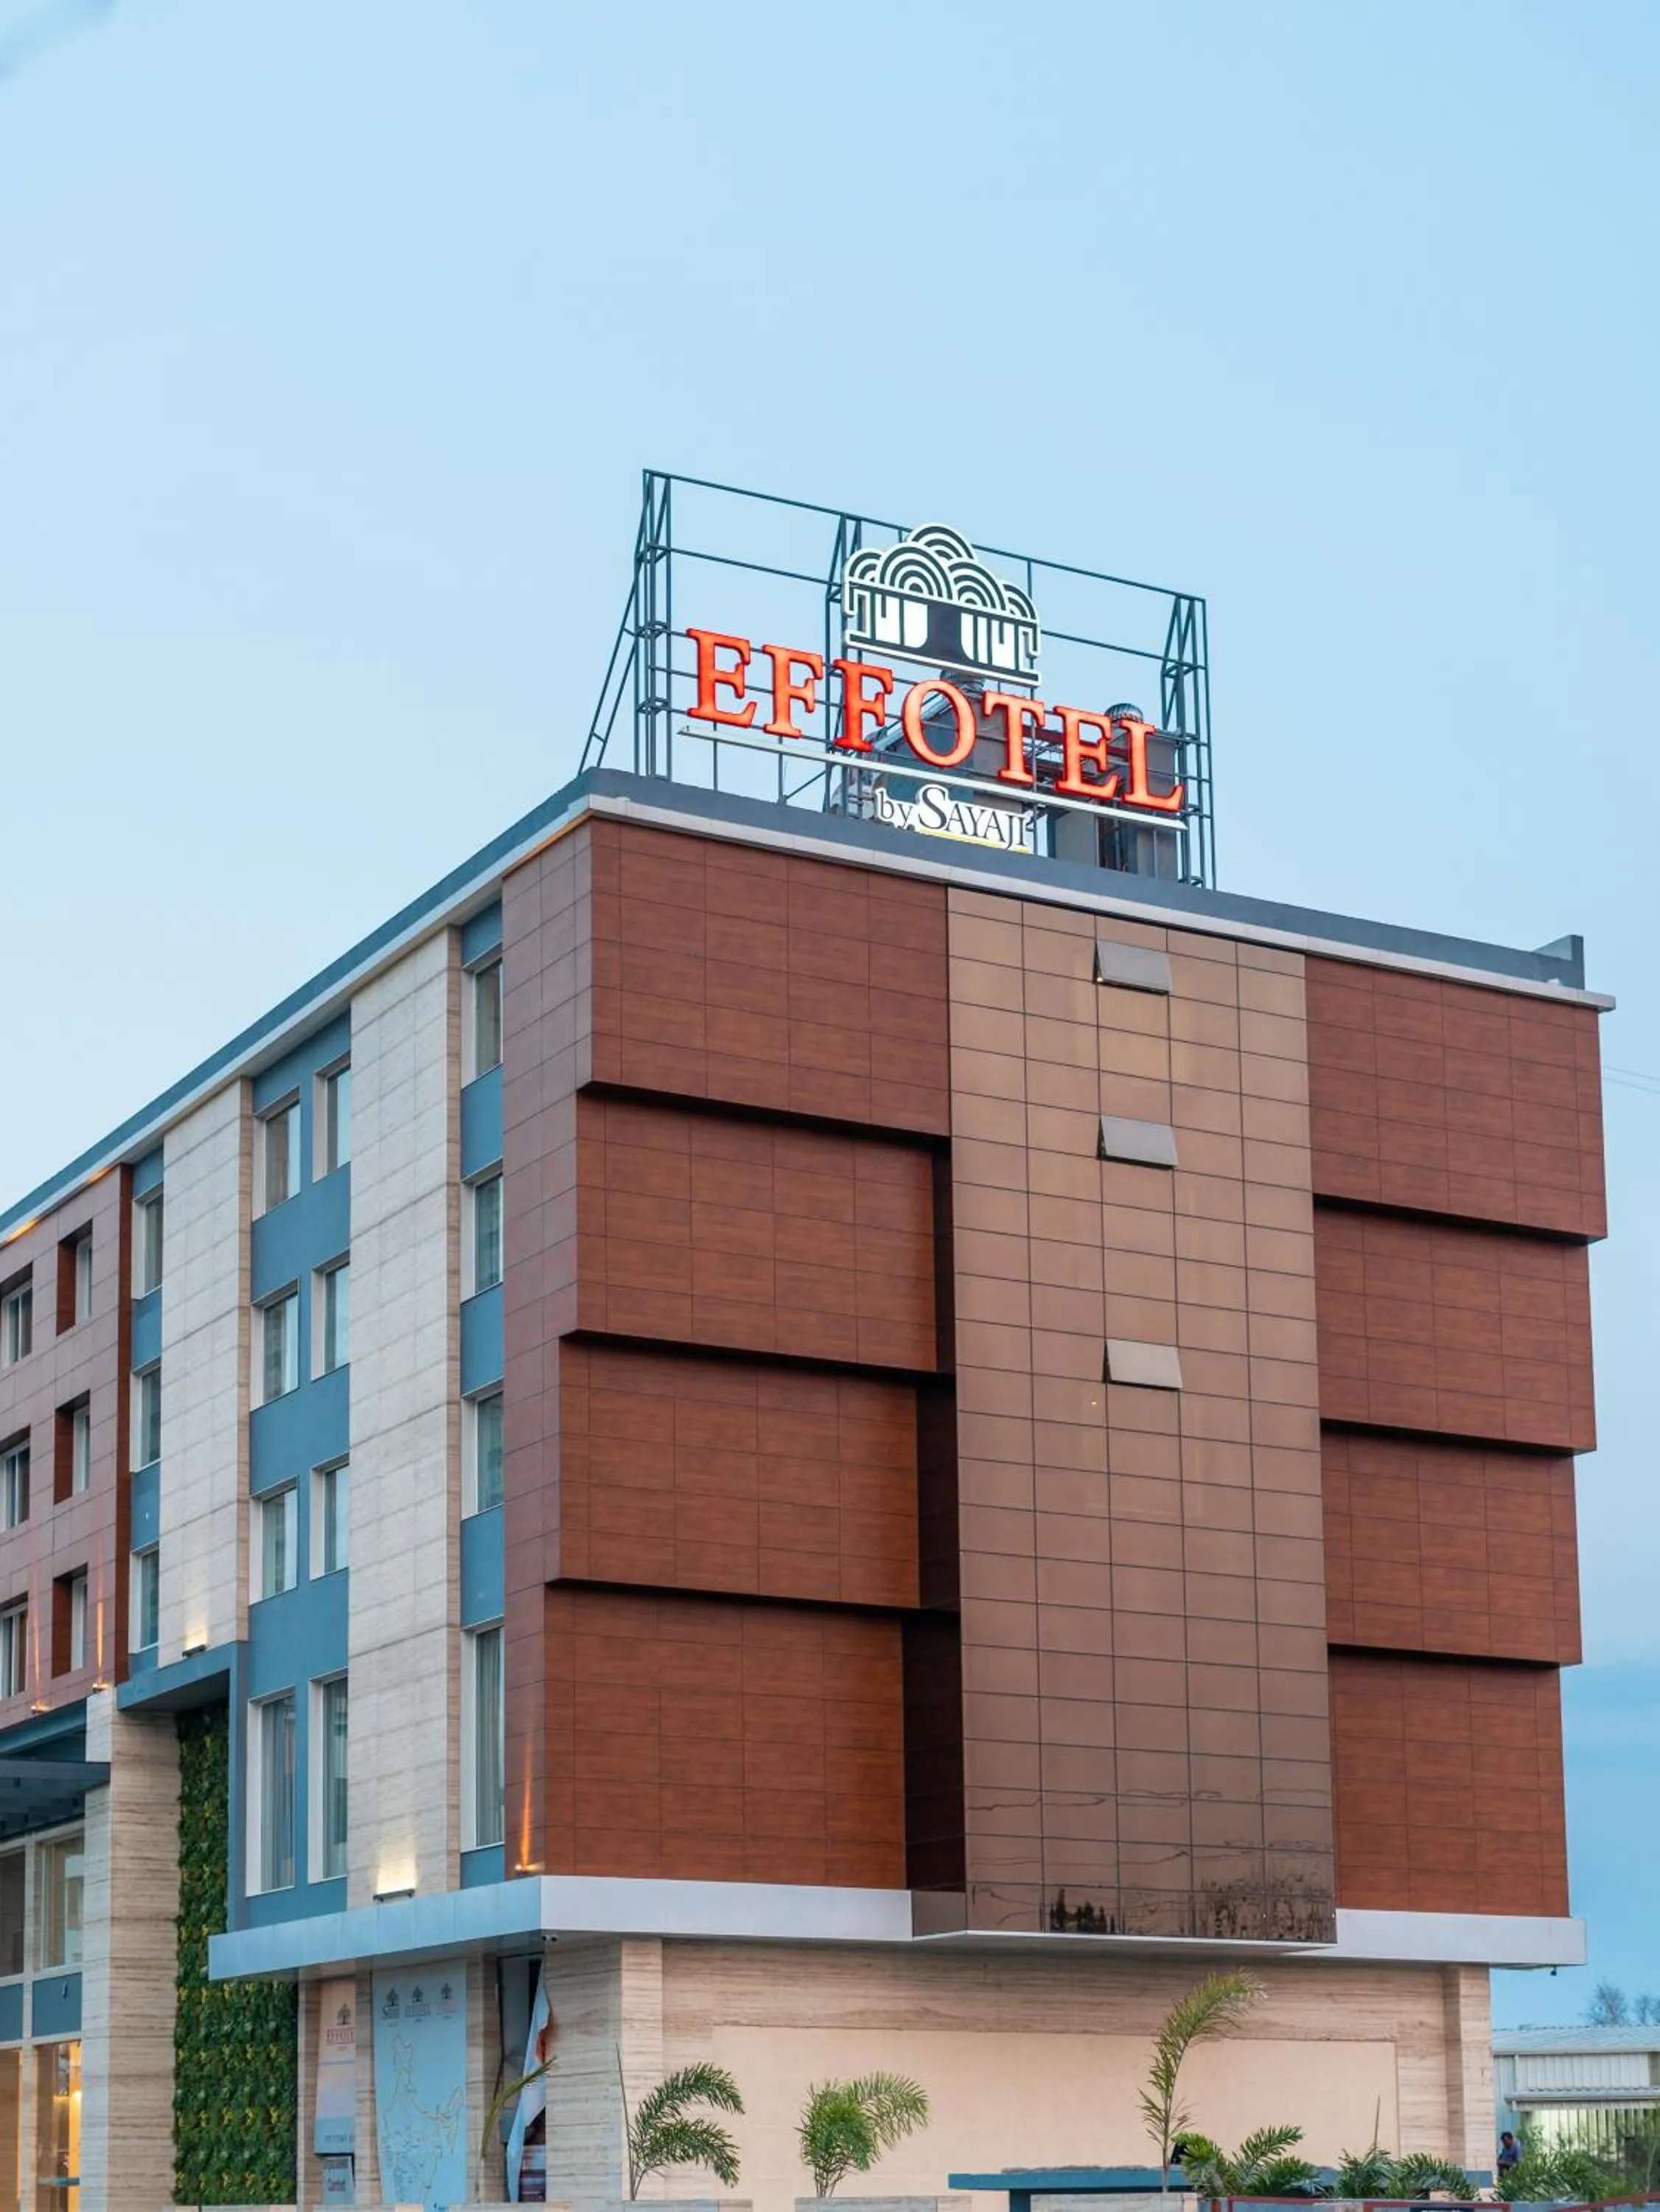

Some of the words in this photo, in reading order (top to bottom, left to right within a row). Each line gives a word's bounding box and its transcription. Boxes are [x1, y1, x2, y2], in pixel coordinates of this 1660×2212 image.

[686, 628, 1183, 813] EFFOTEL
[879, 790, 913, 827] by
[918, 786, 1027, 849] SAYAJI
